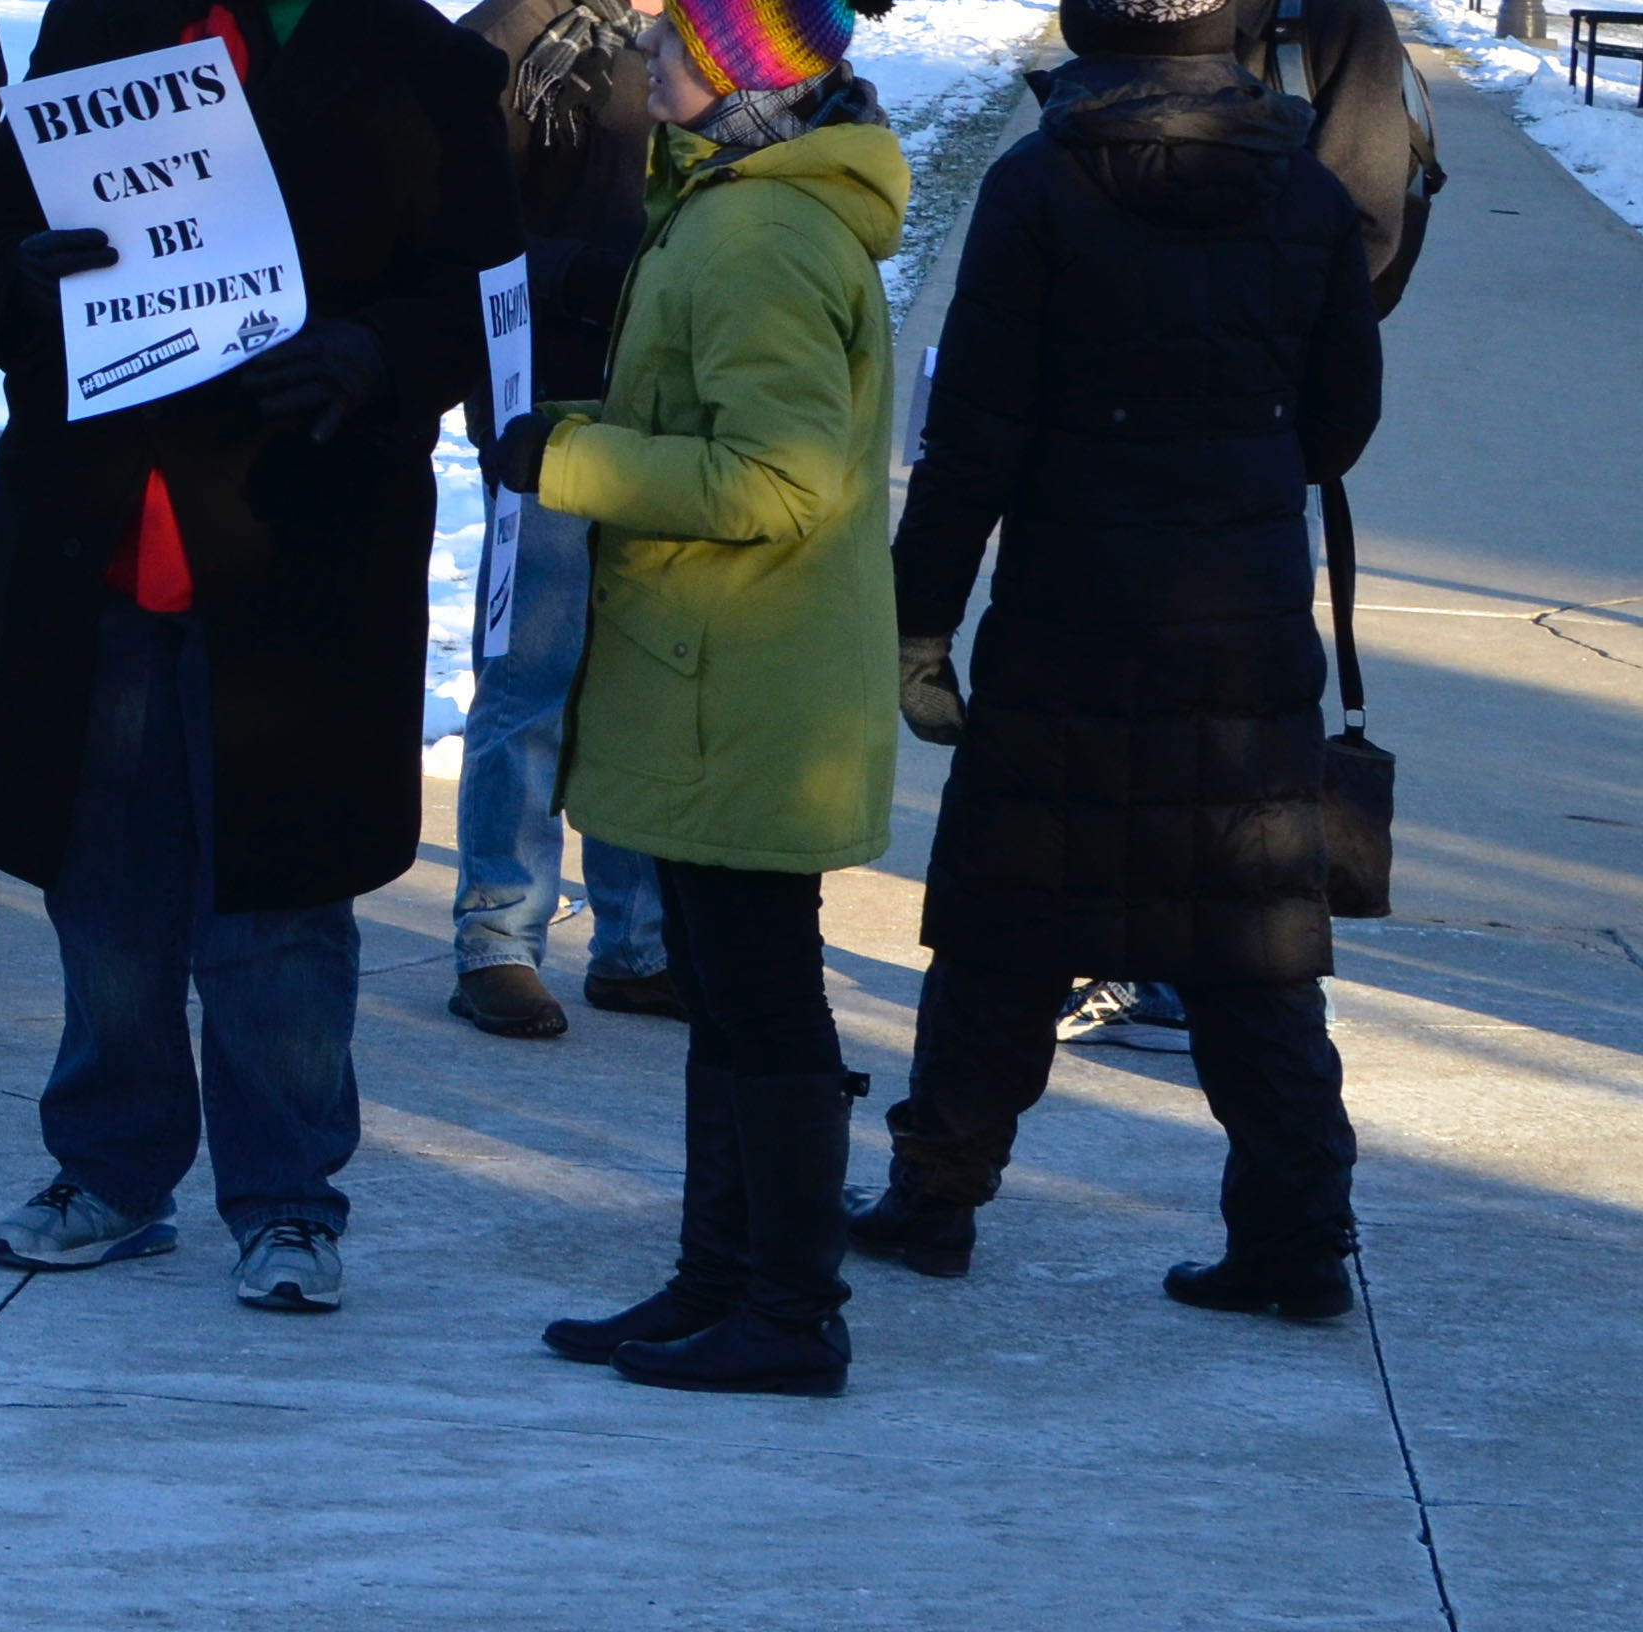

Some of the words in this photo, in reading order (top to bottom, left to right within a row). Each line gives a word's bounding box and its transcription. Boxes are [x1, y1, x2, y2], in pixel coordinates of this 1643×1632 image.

[25, 64, 227, 144] BIGOTS
[92, 149, 213, 202] CAN'T
[146, 217, 204, 258] BE
[84, 265, 284, 327] PRESIDENT
[81, 332, 196, 395] #DumpTrump
